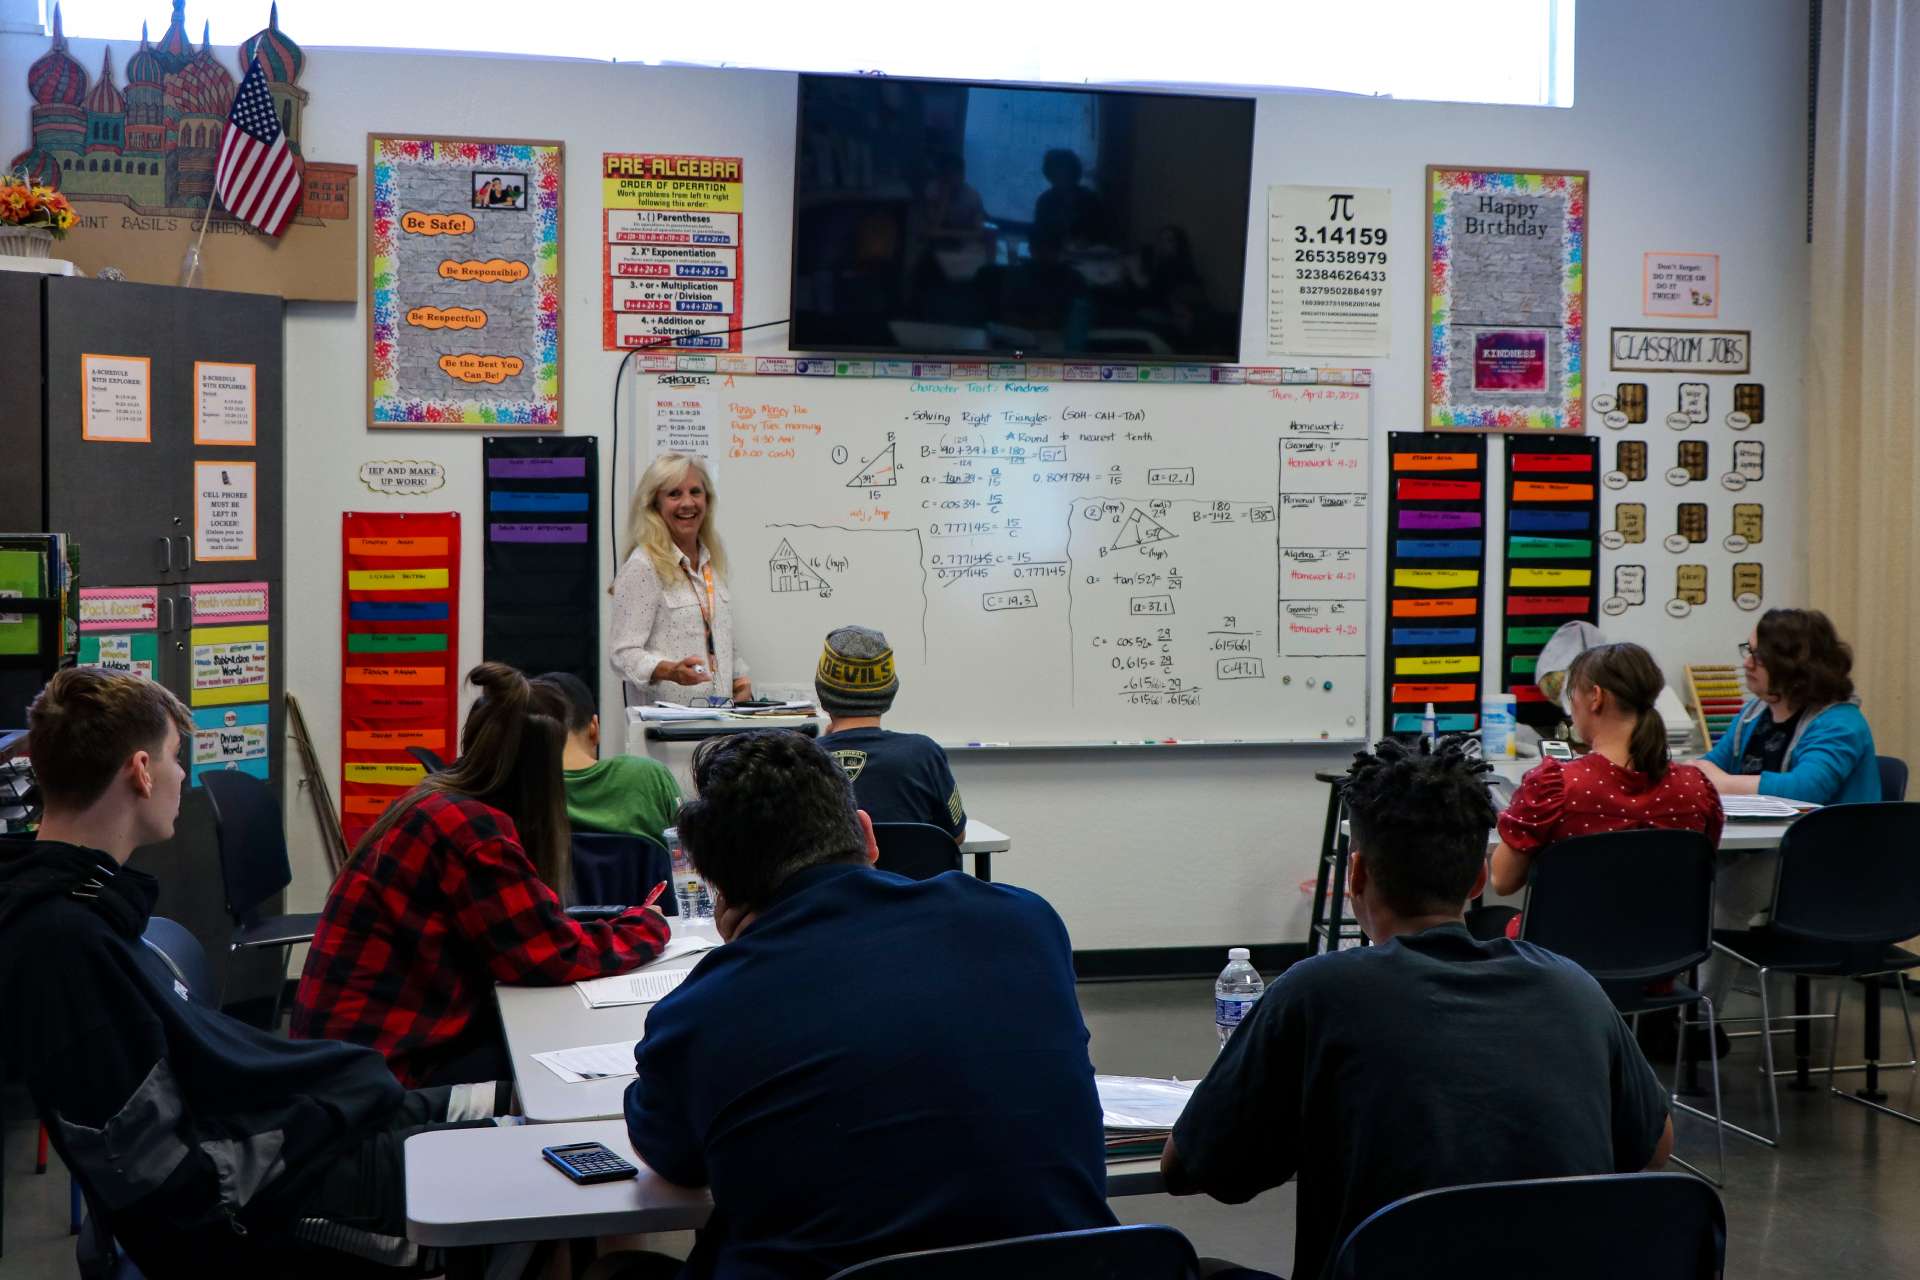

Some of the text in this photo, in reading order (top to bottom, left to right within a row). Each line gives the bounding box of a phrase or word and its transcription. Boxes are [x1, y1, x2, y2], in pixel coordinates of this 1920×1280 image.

[607, 158, 738, 178] PRE-ALGEBRA
[620, 180, 726, 191] ORDER OF OPERATION
[617, 189, 729, 201] Work problems from left to right
[638, 199, 709, 208] following this order:
[1329, 194, 1354, 222] π
[1478, 196, 1539, 218] Happy
[121, 216, 177, 231] BASIL'S
[637, 213, 711, 223] 1. Parentheses
[407, 217, 467, 231] Be Safe!
[1465, 217, 1548, 239] Birthday
[1295, 225, 1388, 246] 3.14159
[631, 247, 716, 259] 2. Exponentiation
[1295, 249, 1387, 265] 265358979
[446, 267, 522, 278] Be Responsible!
[1296, 269, 1386, 282] 32384626433
[630, 282, 638, 290] 3.
[660, 282, 718, 292] Multiplication
[679, 292, 712, 301] Division
[412, 313, 481, 324] Be Respectful!
[641, 317, 705, 326] 4. Addition or
[652, 326, 701, 336] Subtraction
[1483, 349, 1536, 358] KINDNESS
[1615, 335, 1743, 364] CLASSROOM JOBS
[445, 360, 518, 370] Be the Best You
[463, 371, 500, 380] Can Be!
[909, 382, 1049, 393] Character Trait: Kindness
[1302, 389, 1323, 402] April
[761, 404, 788, 418] Money
[912, 410, 951, 425] Solving
[962, 411, 992, 427] Right
[1001, 410, 1048, 427] Triangles
[785, 423, 822, 435] morning
[1290, 420, 1344, 431] Homework:
[732, 434, 744, 448] by
[1018, 432, 1153, 443] Round to nearest tenth
[1288, 457, 1332, 468] Homework
[368, 467, 385, 475] IEP
[387, 467, 407, 475] AND
[380, 478, 427, 487] UP WORK!
[869, 490, 881, 500] 15
[1283, 495, 1316, 505] Personal
[1284, 550, 1314, 560] Algebra
[1290, 570, 1333, 581] Homework
[1286, 603, 1319, 614] Geometry
[1289, 623, 1331, 633] Homework
[102, 660, 130, 671] Addition
[213, 654, 250, 666] Subtraction
[222, 665, 243, 676] Words
[823, 656, 893, 684] DEVILS
[220, 733, 244, 744] Division
[222, 743, 243, 755] Words
